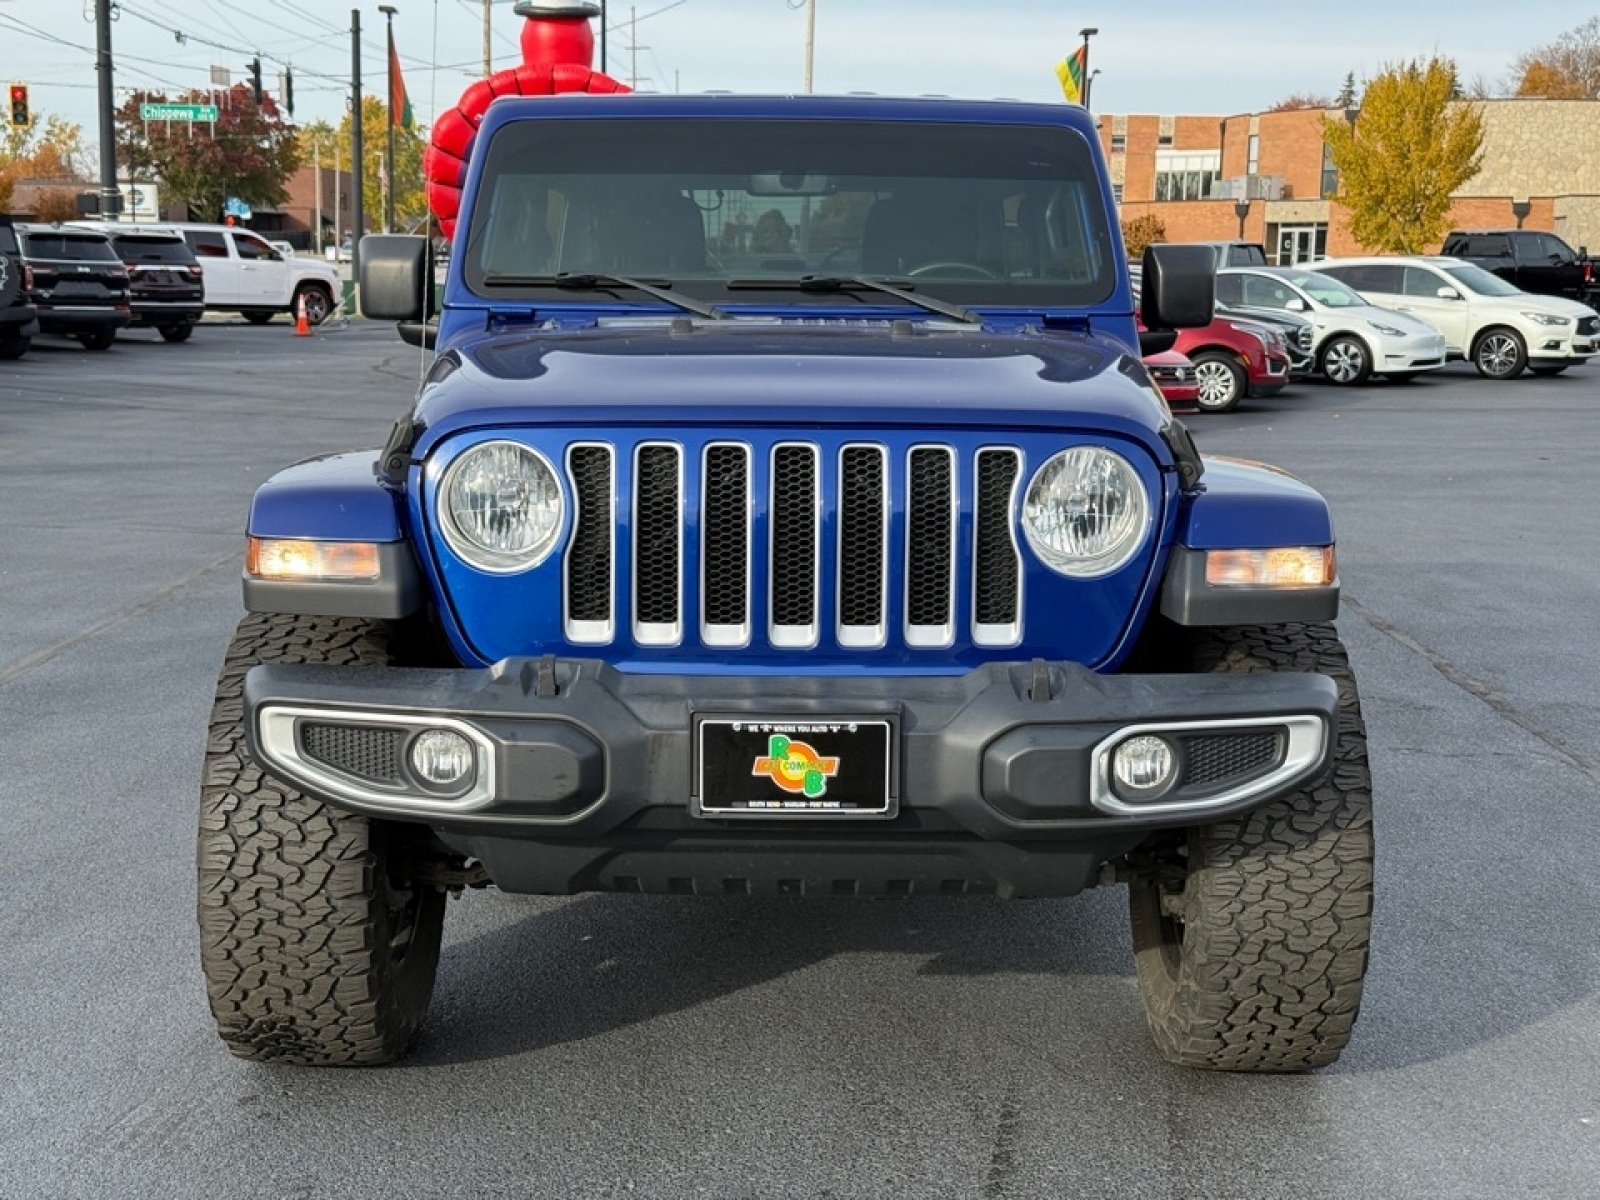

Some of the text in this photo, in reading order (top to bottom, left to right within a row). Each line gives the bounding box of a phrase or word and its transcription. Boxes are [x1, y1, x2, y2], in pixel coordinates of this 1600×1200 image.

[144, 106, 194, 119] Chippewa
[769, 735, 790, 759] R
[803, 770, 827, 797] B
